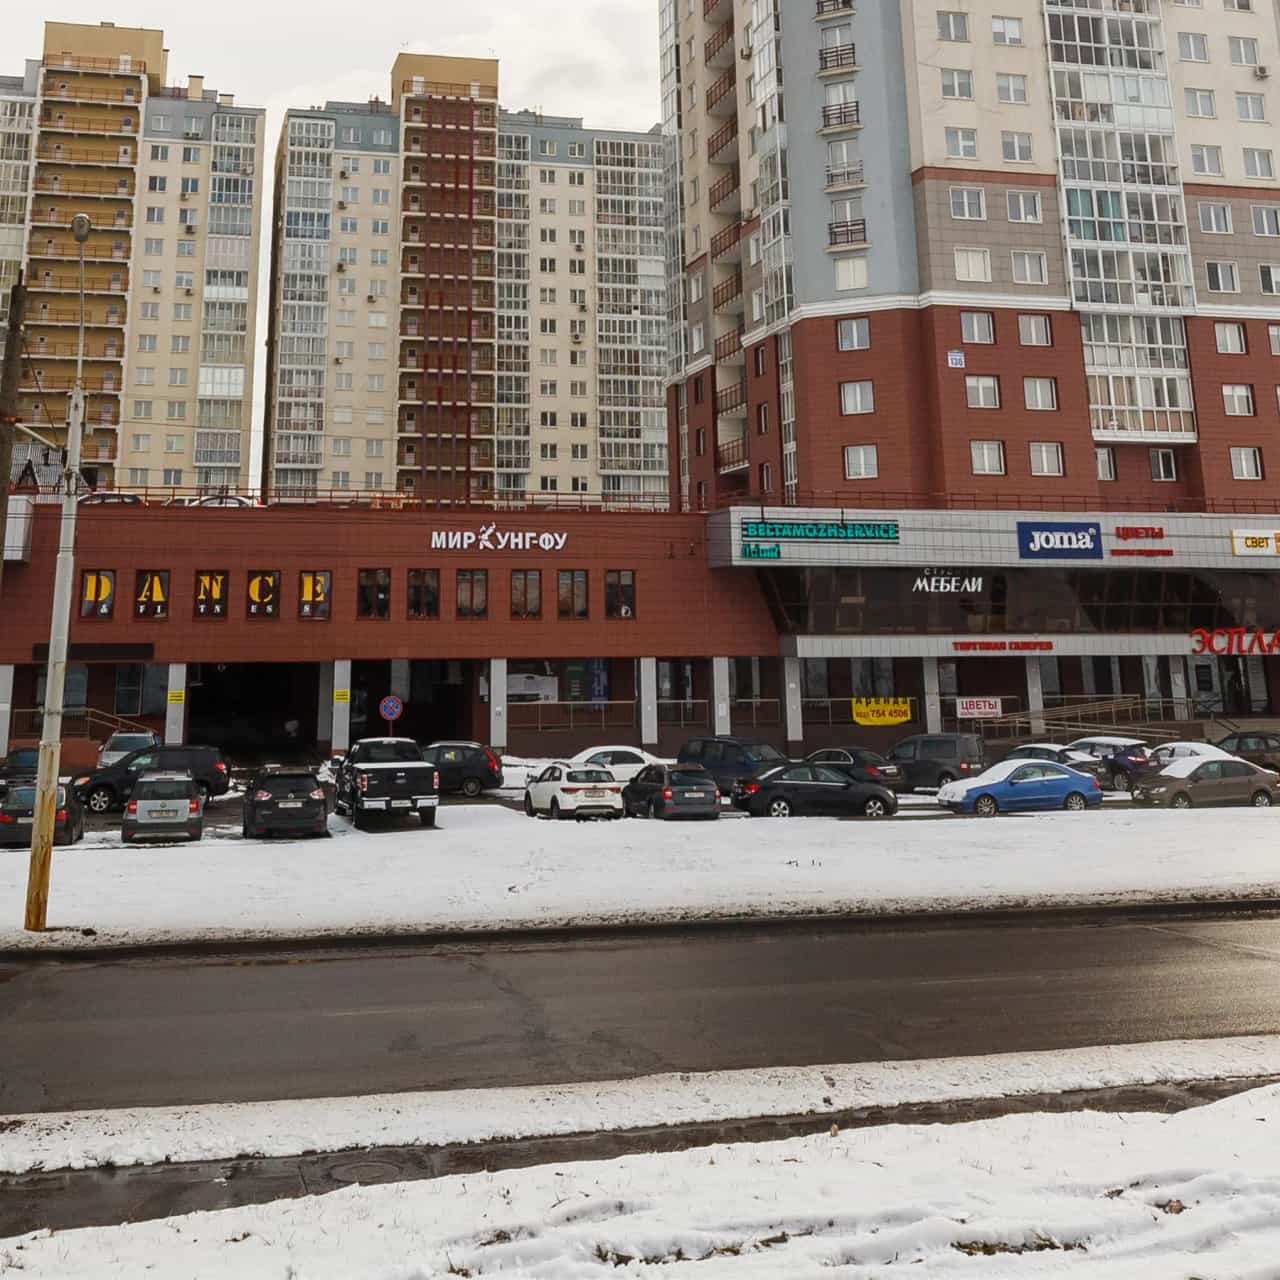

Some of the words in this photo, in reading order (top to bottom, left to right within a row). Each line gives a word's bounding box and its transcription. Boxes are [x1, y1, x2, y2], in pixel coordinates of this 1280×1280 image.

[431, 531, 476, 549] МИР
[85, 575, 324, 602] DANCE
[912, 577, 983, 592] МЕБЕЛИ
[961, 700, 997, 711] ЦВЕТЫ
